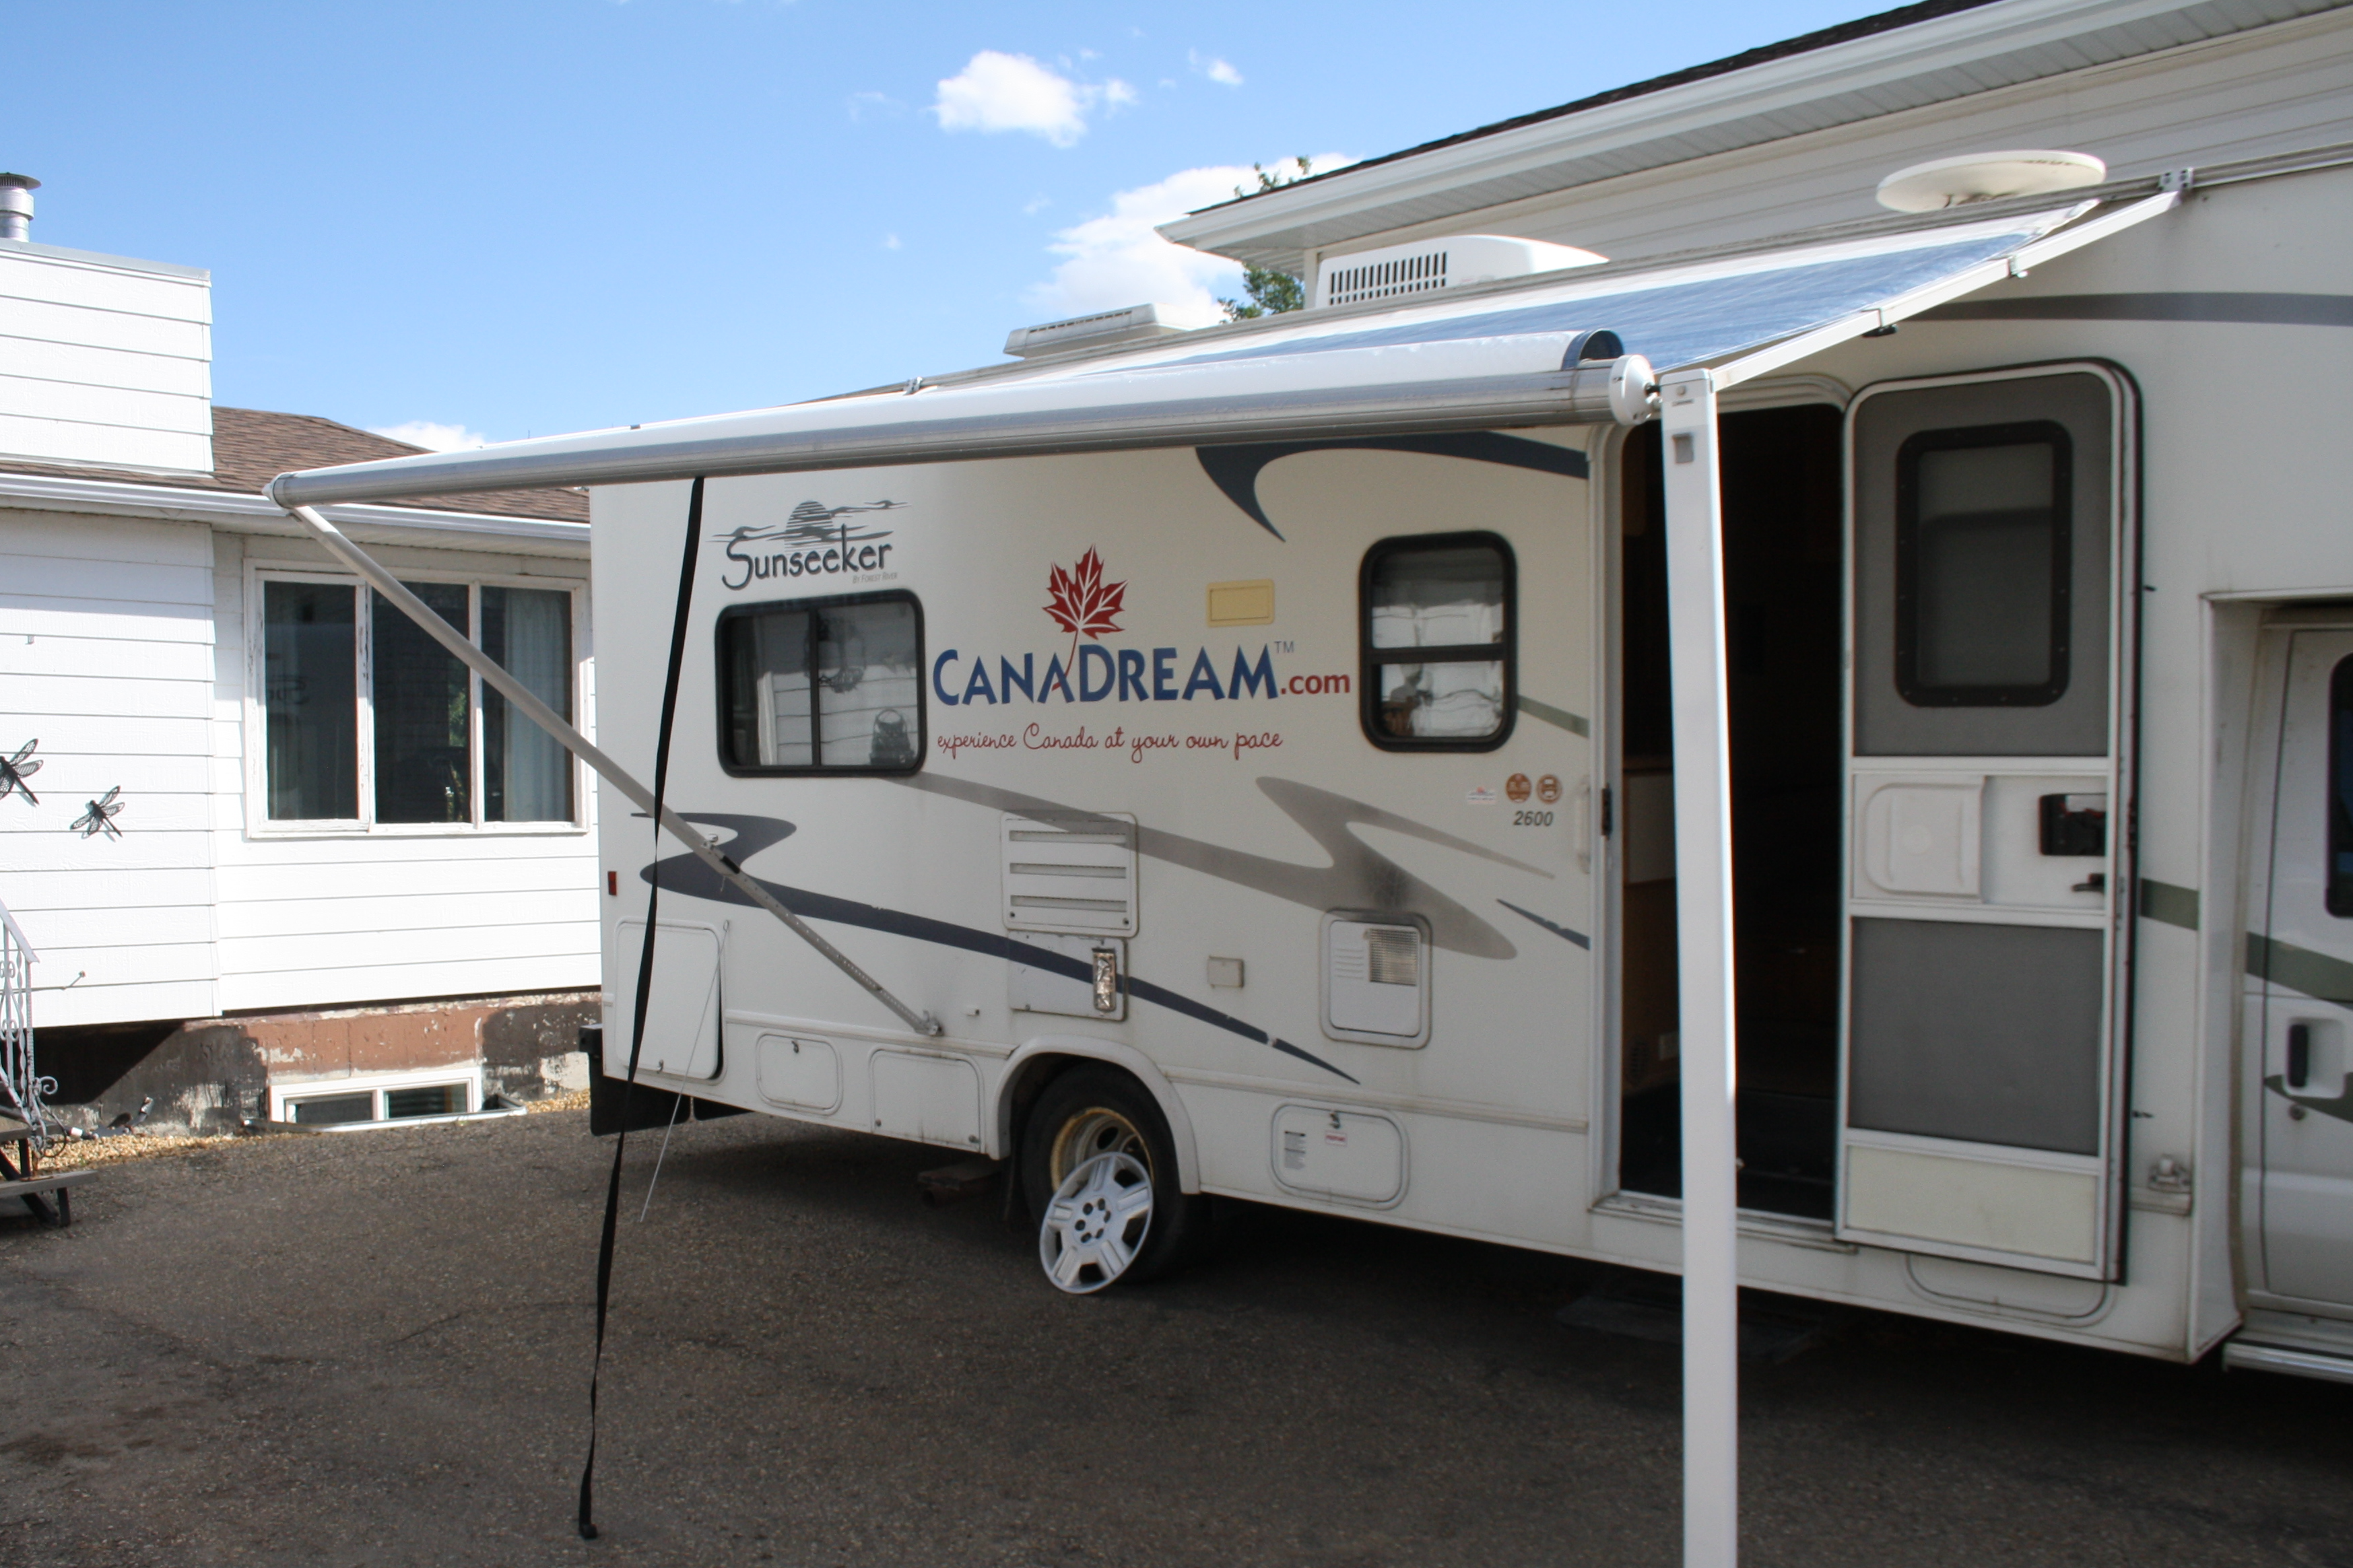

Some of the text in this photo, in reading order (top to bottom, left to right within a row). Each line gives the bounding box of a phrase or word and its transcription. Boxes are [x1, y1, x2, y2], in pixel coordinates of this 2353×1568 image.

[722, 523, 893, 590] Sunseeker
[937, 722, 1284, 763] experience Canada at your own pace
[1513, 810, 1554, 827] 2600
